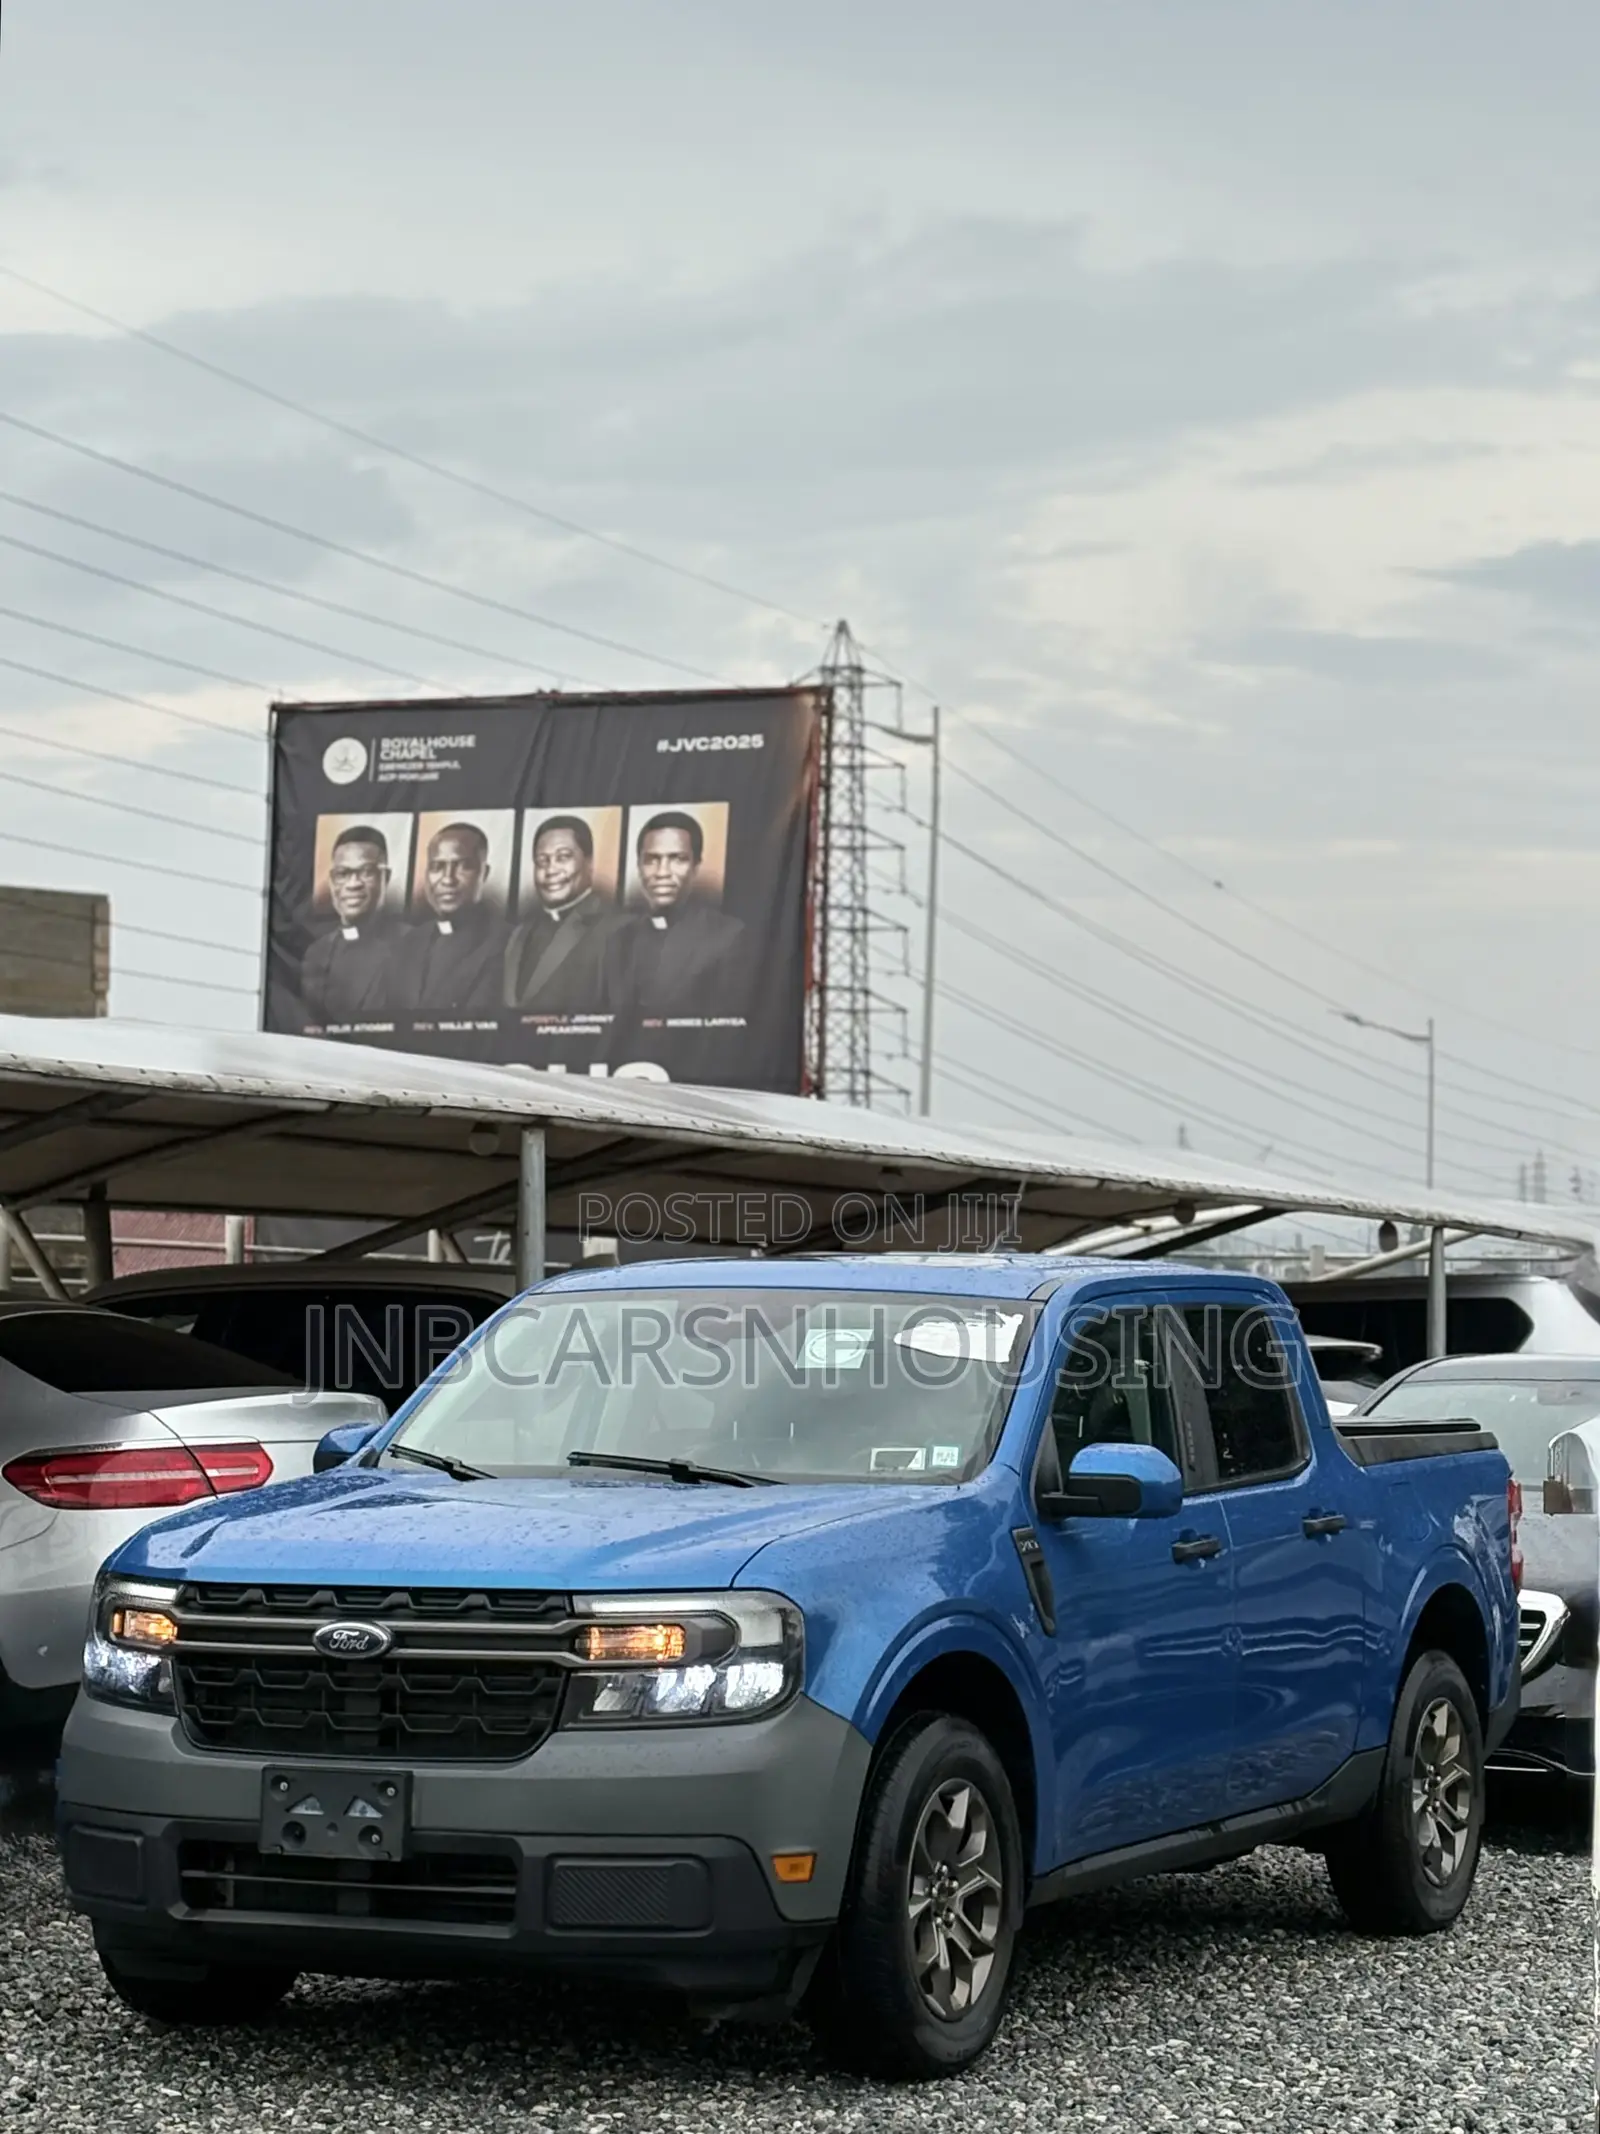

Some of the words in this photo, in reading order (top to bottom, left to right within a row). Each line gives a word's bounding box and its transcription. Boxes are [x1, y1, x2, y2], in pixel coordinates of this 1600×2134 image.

[381, 734, 476, 750] ROYALHOUSE
[656, 733, 764, 753] #JVC2025
[380, 748, 437, 760] CHAPEL
[329, 1629, 370, 1650] Ford
